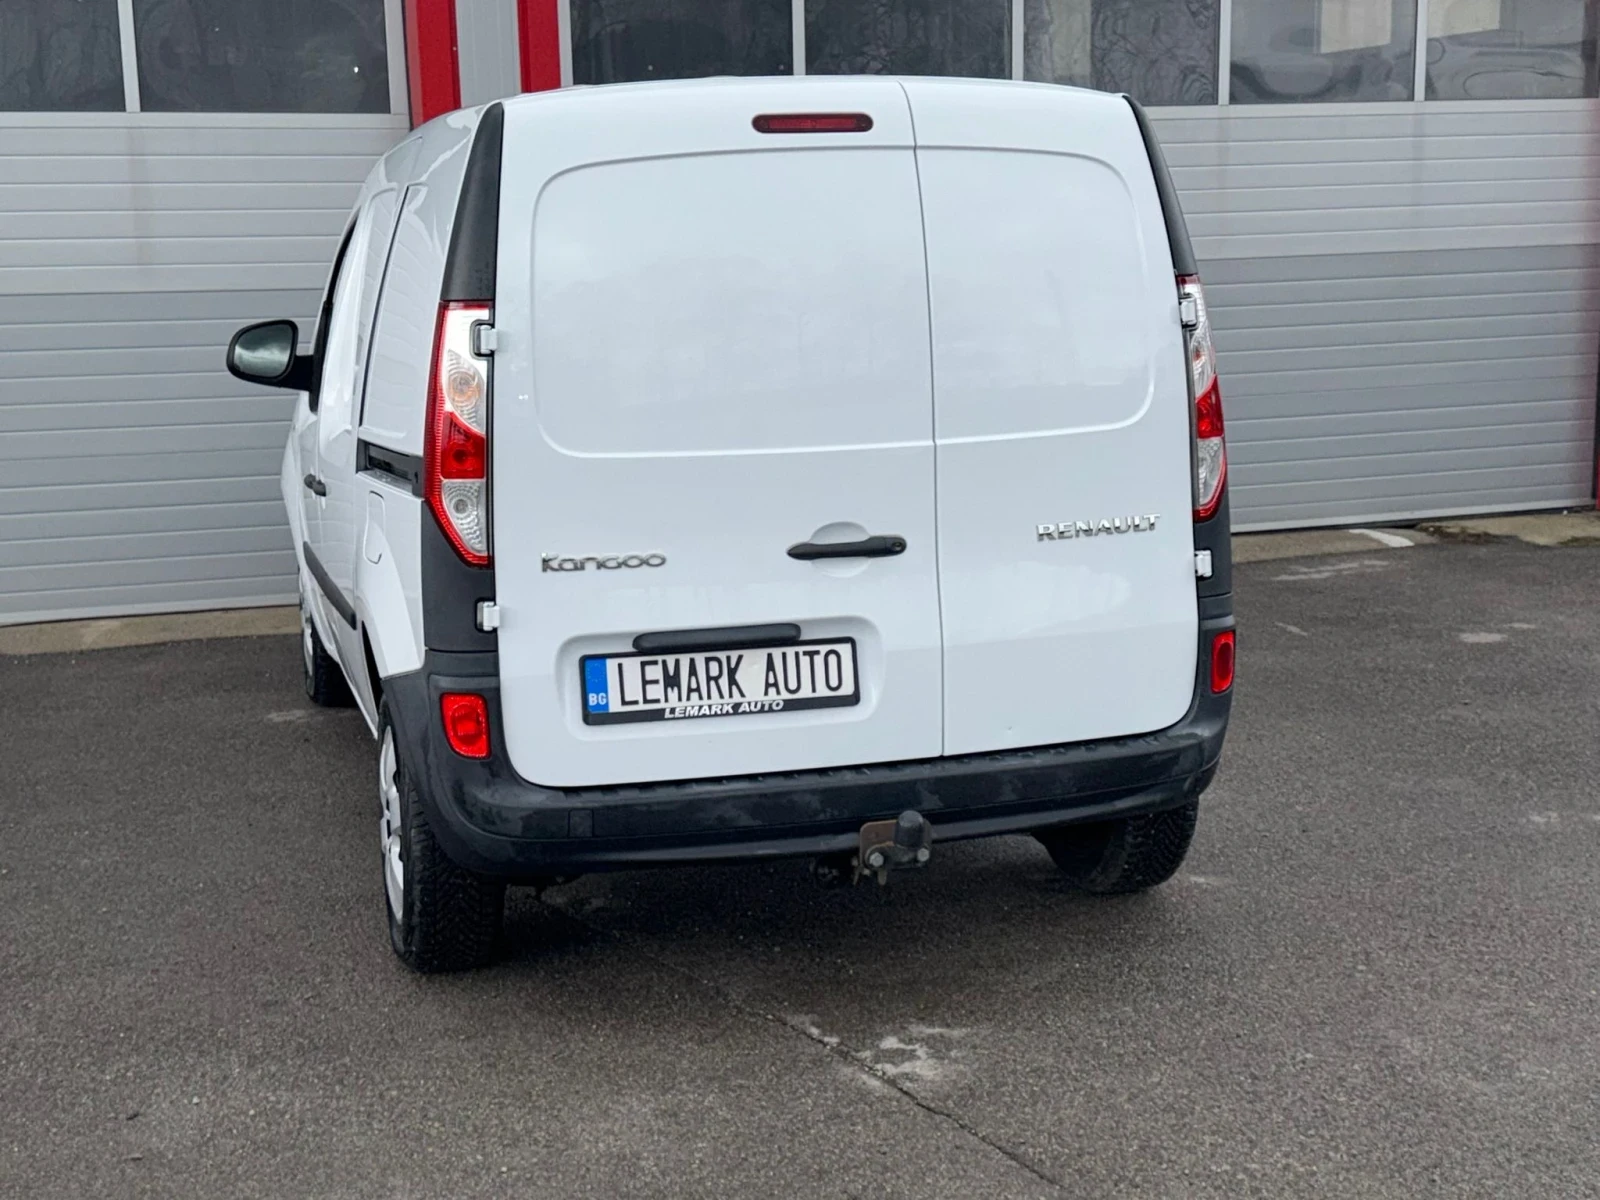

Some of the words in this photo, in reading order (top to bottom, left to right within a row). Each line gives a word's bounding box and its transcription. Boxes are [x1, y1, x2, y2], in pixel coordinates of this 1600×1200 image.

[1037, 513, 1161, 541] RENAULT
[617, 654, 746, 706] LEMARK
[763, 649, 843, 697] AUTO
[588, 693, 607, 706] BG
[664, 703, 734, 719] LEMARK
[738, 700, 784, 713] AUTO
